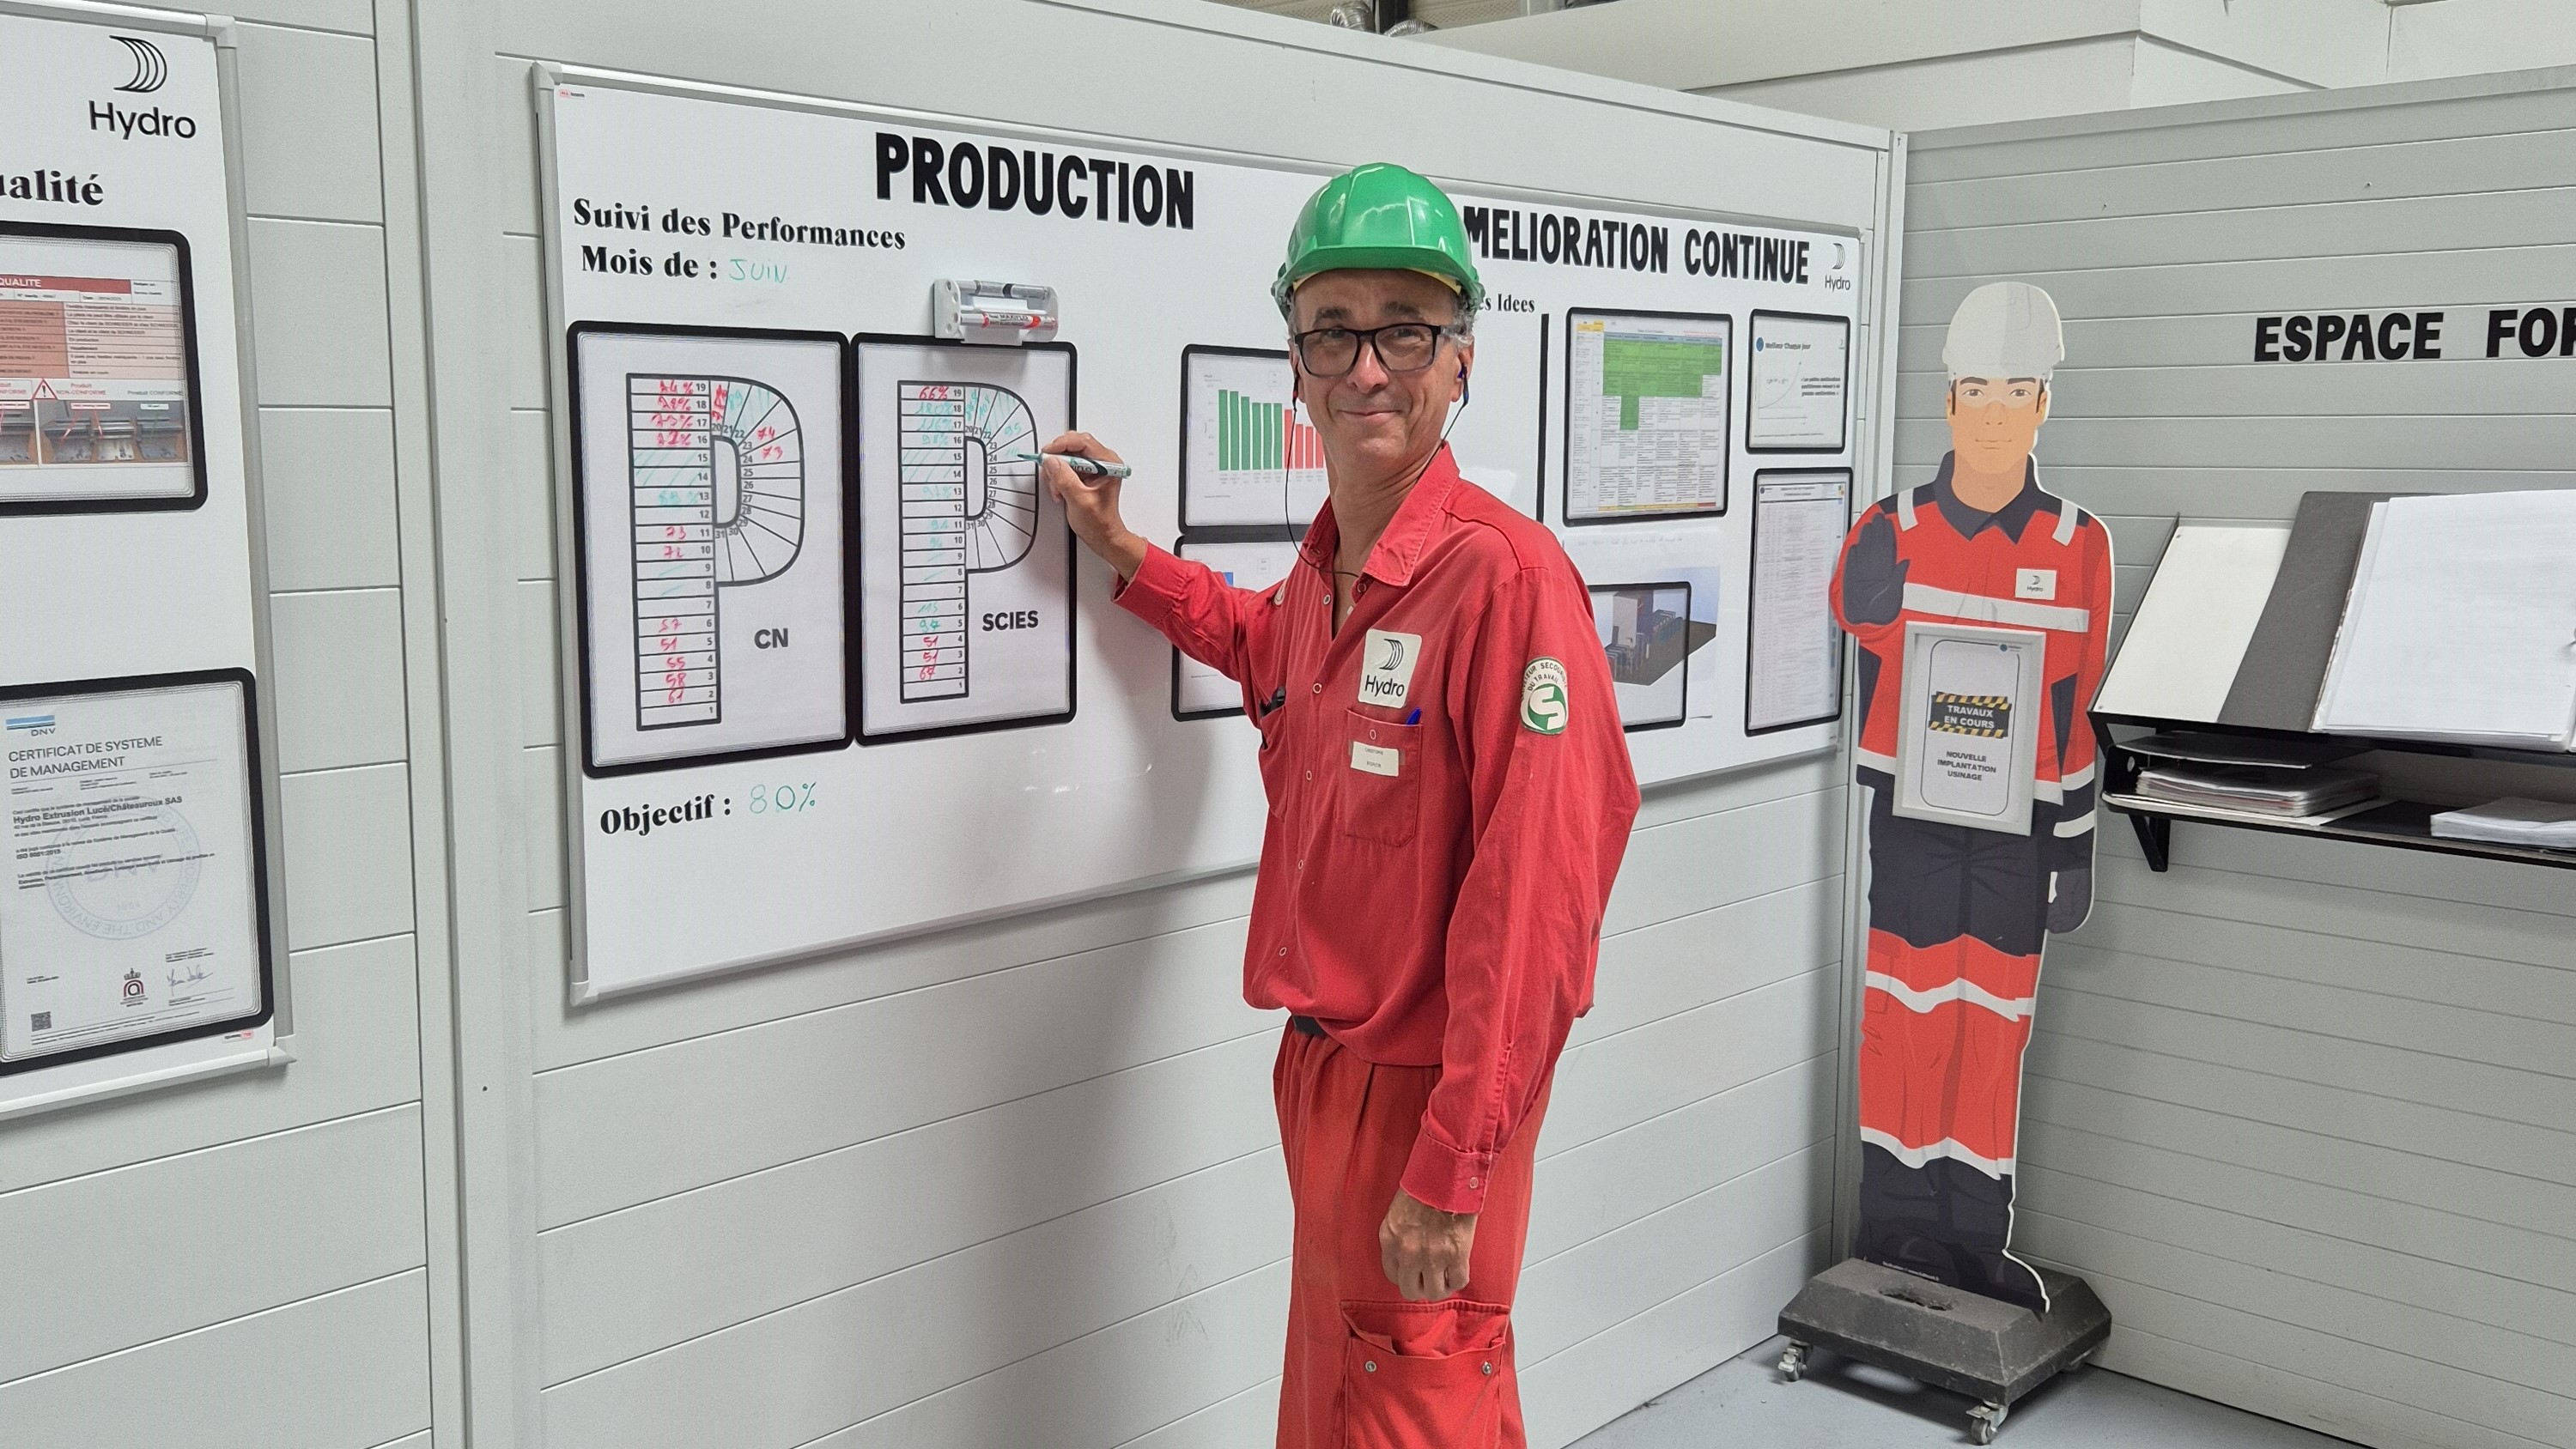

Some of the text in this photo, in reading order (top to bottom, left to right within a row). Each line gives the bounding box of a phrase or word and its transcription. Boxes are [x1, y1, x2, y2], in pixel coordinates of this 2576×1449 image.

[89, 100, 196, 140] Hydro
[875, 132, 1194, 230] PRODUCTION
[574, 198, 905, 250] Suivi des Performances
[1463, 206, 1809, 284] MELIORATION CONTINUE
[580, 246, 653, 275] Mois
[664, 252, 698, 278] de
[1825, 275, 1850, 292] Hydro
[1498, 294, 1535, 312] Idees
[2254, 312, 2444, 362] ESPACE
[696, 383, 706, 392] 19
[919, 386, 949, 400] 66%
[697, 400, 707, 409] 18
[953, 404, 962, 413] 18
[697, 418, 707, 427] 17
[953, 421, 962, 429] 17
[712, 423, 721, 432] 20
[723, 425, 732, 433] 21
[965, 425, 973, 433] 20
[974, 426, 981, 435] 21
[982, 430, 992, 439] 22
[697, 435, 708, 444] 16
[953, 436, 962, 445] 16
[989, 441, 998, 450] 23
[698, 453, 708, 463] 15
[743, 455, 752, 464] 24
[989, 454, 998, 463] 24
[698, 472, 708, 482] 14
[989, 477, 998, 486] 26
[744, 481, 753, 489] 26
[699, 492, 709, 501] 13
[953, 488, 962, 496] 13
[988, 489, 996, 498] 27
[743, 494, 752, 503] 27
[954, 504, 962, 512] 12
[987, 500, 996, 509] 28
[700, 509, 709, 519] 12
[742, 506, 751, 515] 28
[985, 512, 993, 520] 29
[966, 522, 974, 530] 31
[977, 519, 985, 528] 30
[701, 528, 710, 537] 11
[701, 545, 710, 555] 10
[705, 564, 710, 573] 9
[706, 580, 711, 589] 8
[707, 601, 711, 609] 7
[957, 603, 963, 611] 6
[707, 619, 712, 627] 6
[981, 610, 1039, 631] SCIES
[754, 627, 789, 649] CN
[708, 655, 713, 664] 4
[708, 672, 713, 681] 3
[1365, 675, 1405, 697] Hydro
[1947, 705, 1993, 718] TRAVAUX
[1944, 716, 1995, 729] EN COURS
[31, 728, 56, 737] DNV
[9, 737, 162, 761] CERTIFICAT DE SYSTEME
[1947, 751, 1986, 762] NOUVELLE
[10, 756, 125, 779] DE MANAGEMENT
[1937, 759, 1996, 773] IMPLANTATION
[1947, 770, 1983, 781] USINAGE
[750, 782, 816, 814] 80%
[14, 814, 40, 824] Hydro
[43, 809, 85, 821] Extrusion
[165, 796, 182, 805] SAS
[600, 794, 714, 836] Objectif
